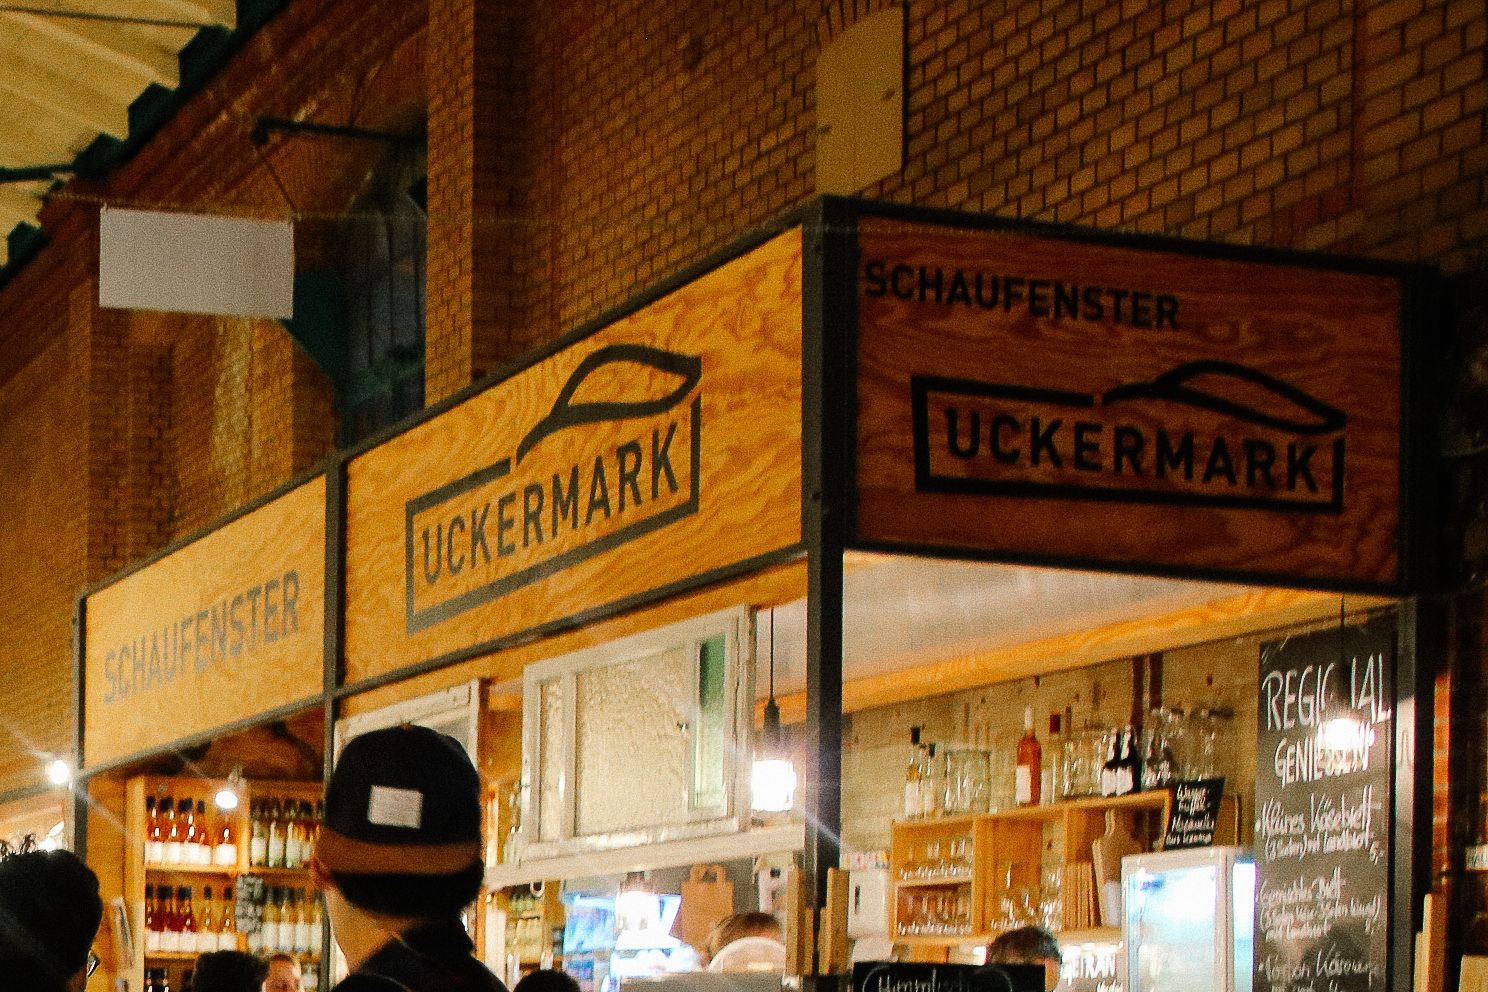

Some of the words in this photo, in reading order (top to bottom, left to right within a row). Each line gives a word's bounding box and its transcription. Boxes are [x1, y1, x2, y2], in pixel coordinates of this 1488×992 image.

[863, 260, 1180, 331] SCHAUFENSTER
[945, 409, 1320, 493] UCKERMARK
[419, 419, 682, 586] UCKERMARK
[102, 568, 300, 704] SCHAUFENSTER
[1261, 652, 1392, 731] REGIAL
